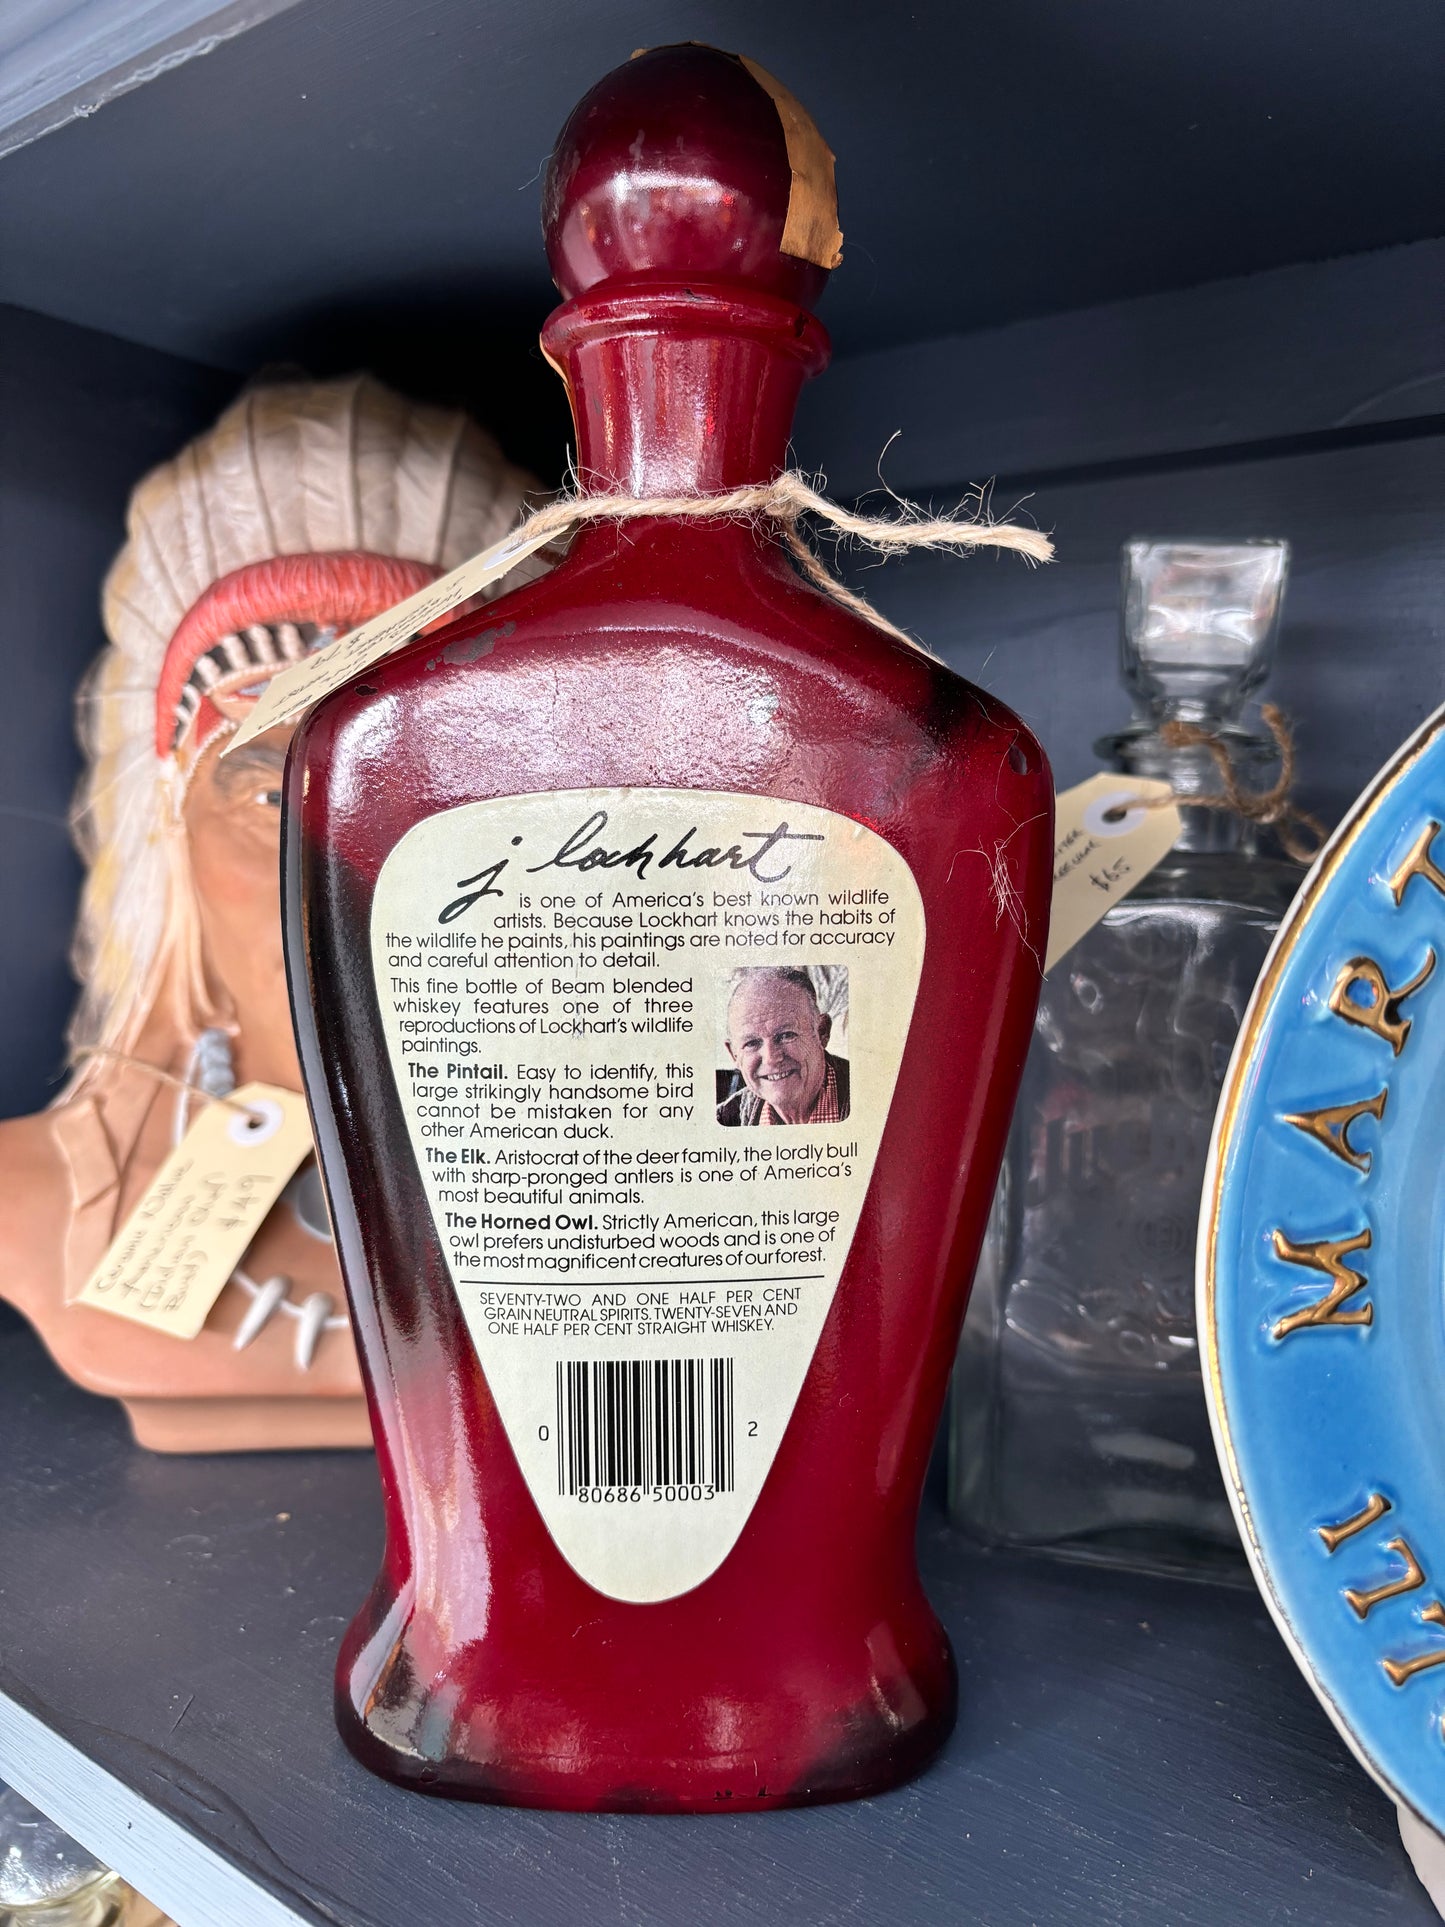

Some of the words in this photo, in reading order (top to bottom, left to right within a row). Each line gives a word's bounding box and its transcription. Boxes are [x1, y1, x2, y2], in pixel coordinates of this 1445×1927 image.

[519, 892, 532, 909] is
[540, 896, 576, 909] one
[584, 891, 603, 908] of
[612, 891, 704, 908] America's
[713, 890, 752, 907] best
[761, 889, 819, 906] known
[828, 888, 889, 906] wildlife
[493, 912, 546, 929] artists.
[554, 912, 634, 931] Because
[637, 911, 718, 928] Lockhart
[724, 907, 780, 927] knows
[785, 909, 814, 930] the
[819, 908, 873, 926] habits
[878, 908, 896, 924] of
[385, 932, 412, 948] the
[416, 932, 477, 949] wildlife
[481, 932, 504, 949] he
[508, 932, 568, 952] paints,
[572, 930, 597, 949] his
[601, 931, 685, 952] paintings
[689, 934, 721, 948] are
[725, 930, 778, 947] noted
[781, 929, 806, 946] for
[809, 931, 896, 947] accuracy
[388, 952, 422, 968] and
[427, 952, 488, 968] careful
[494, 950, 574, 968] attention
[578, 952, 597, 968] to
[602, 951, 660, 968] detail.
[390, 977, 420, 993] This
[426, 977, 459, 994] fine
[465, 978, 518, 994] bottle
[525, 978, 544, 994] of
[552, 978, 605, 998] Beam
[613, 977, 693, 994] blended
[393, 997, 461, 1017] whiskey
[473, 998, 549, 1015] features
[562, 1000, 600, 1015] one
[612, 997, 632, 1014] of
[644, 997, 694, 1014] three
[399, 1017, 516, 1036] reproductions
[519, 1018, 537, 1034] of
[540, 1016, 628, 1034] Lockhart's
[631, 1016, 694, 1033] wildlife
[402, 1036, 482, 1057] paintings.
[407, 1062, 439, 1079] The
[447, 1063, 508, 1080] Pintail.
[517, 1064, 557, 1083] Easy
[563, 1064, 582, 1080] to
[590, 1063, 658, 1082] identify,
[665, 1063, 694, 1079] this
[412, 1082, 459, 1102] large
[465, 1083, 542, 1103] strikingly
[549, 1083, 650, 1103] handsome
[654, 1082, 694, 1099] bird
[416, 1103, 480, 1119] cannot
[490, 1103, 516, 1119] be
[527, 1102, 612, 1120] mistaken
[622, 1102, 648, 1119] for
[659, 1105, 694, 1121] any
[421, 1121, 465, 1138] other
[469, 1122, 558, 1139] American
[563, 1123, 614, 1139] duck.
[425, 1147, 458, 1164] The
[461, 1148, 491, 1164] Elk.
[494, 1149, 580, 1166] Aristocrat
[582, 1149, 601, 1166] of
[602, 1149, 633, 1165] the
[636, 1149, 680, 1165] deer
[681, 1147, 740, 1166] family,
[743, 1146, 772, 1162] the
[776, 1143, 824, 1163] lordly
[826, 1141, 858, 1159] bull
[432, 1167, 466, 1183] with
[471, 1168, 608, 1189] sharp-pronged
[614, 1168, 674, 1185] antlers
[680, 1167, 693, 1183] is
[698, 1167, 734, 1183] one
[739, 1165, 760, 1182] of
[763, 1161, 852, 1181] America's
[439, 1187, 479, 1203] most
[484, 1187, 563, 1205] beautiful
[568, 1188, 644, 1205] animals.
[445, 1212, 477, 1229] The
[481, 1213, 551, 1230] Horned
[555, 1214, 598, 1230] Owl.
[602, 1213, 660, 1232] Strictly
[663, 1212, 758, 1229] American,
[760, 1210, 790, 1226] this
[793, 1209, 840, 1227] large
[449, 1232, 479, 1248] owl
[483, 1233, 544, 1252] prefers
[547, 1232, 655, 1250] undisturbed
[659, 1229, 720, 1248] woods
[723, 1230, 761, 1247] and
[764, 1229, 777, 1246] is
[780, 1231, 815, 1245] one
[818, 1226, 836, 1243] of
[453, 1251, 481, 1268] the
[483, 1253, 525, 1269] most
[527, 1252, 637, 1273] magnificent
[638, 1251, 723, 1269] creatures
[725, 1250, 743, 1266] of
[744, 1252, 774, 1265] our
[774, 1246, 826, 1264] forest.
[480, 1292, 582, 1307] SEVENTY-TWO
[591, 1293, 627, 1307] AND
[636, 1292, 669, 1306] ONE
[679, 1291, 716, 1305] HALF
[726, 1289, 753, 1303] PER
[762, 1287, 802, 1302] CENT
[484, 1307, 531, 1321] GRAIN
[534, 1308, 598, 1322] NEUTRAL
[600, 1307, 652, 1322] SPIRITS.
[653, 1304, 762, 1320] TWENTY-SEVEN
[764, 1302, 798, 1317] AND
[488, 1321, 519, 1335] ONE
[524, 1323, 559, 1336] HALF
[563, 1323, 590, 1336] PER
[594, 1322, 633, 1336] CENT
[637, 1317, 707, 1335] STRAIGHT
[711, 1318, 774, 1333] WHISKEY.
[538, 1425, 549, 1441] 0
[748, 1421, 758, 1437] 2
[577, 1486, 642, 1503] 80686
[653, 1485, 715, 1501] 50003
[1318, 1493, 1445, 1744] LLI
